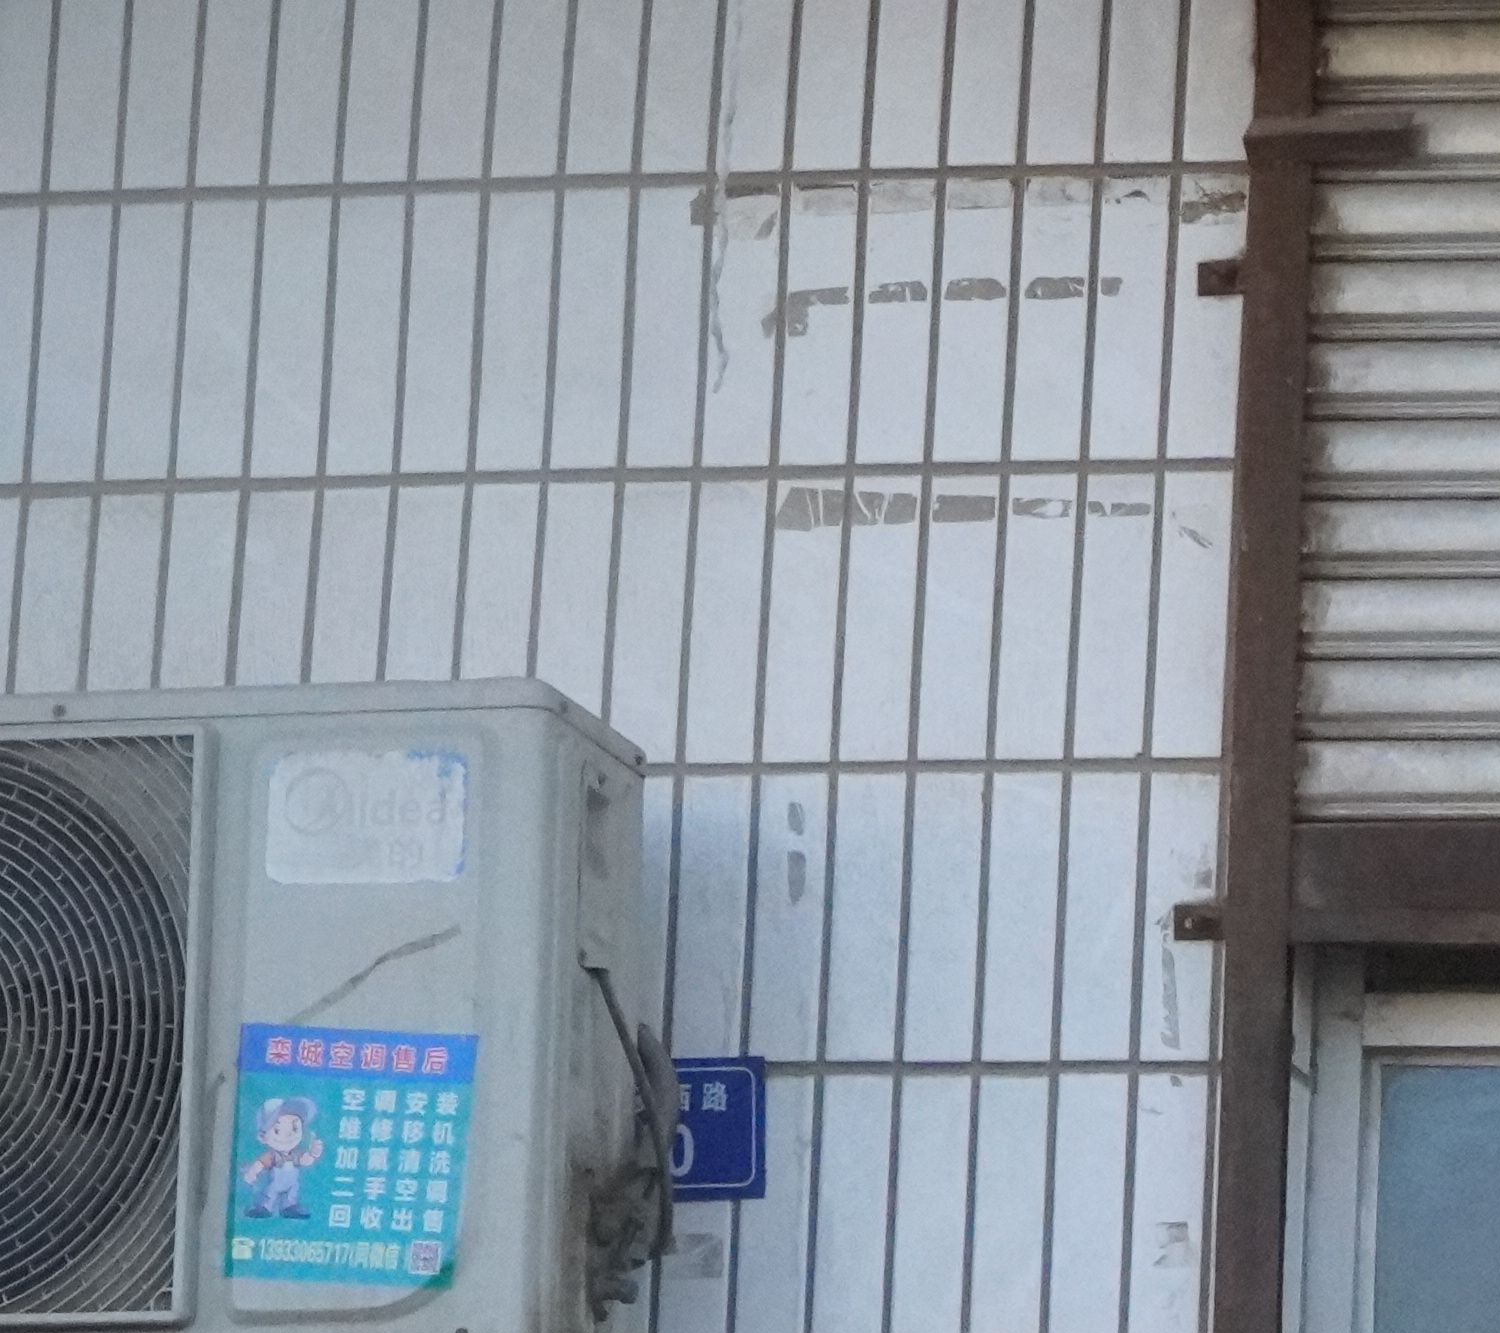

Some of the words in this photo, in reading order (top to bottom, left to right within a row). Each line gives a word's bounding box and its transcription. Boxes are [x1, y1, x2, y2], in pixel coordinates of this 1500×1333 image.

[265, 1036, 448, 1075] 栾城空调售后
[342, 1088, 459, 1116] 空调安装
[338, 1116, 454, 1146] 维修移机
[331, 1176, 448, 1204] 二手空调
[329, 1203, 445, 1234] 回收出售
